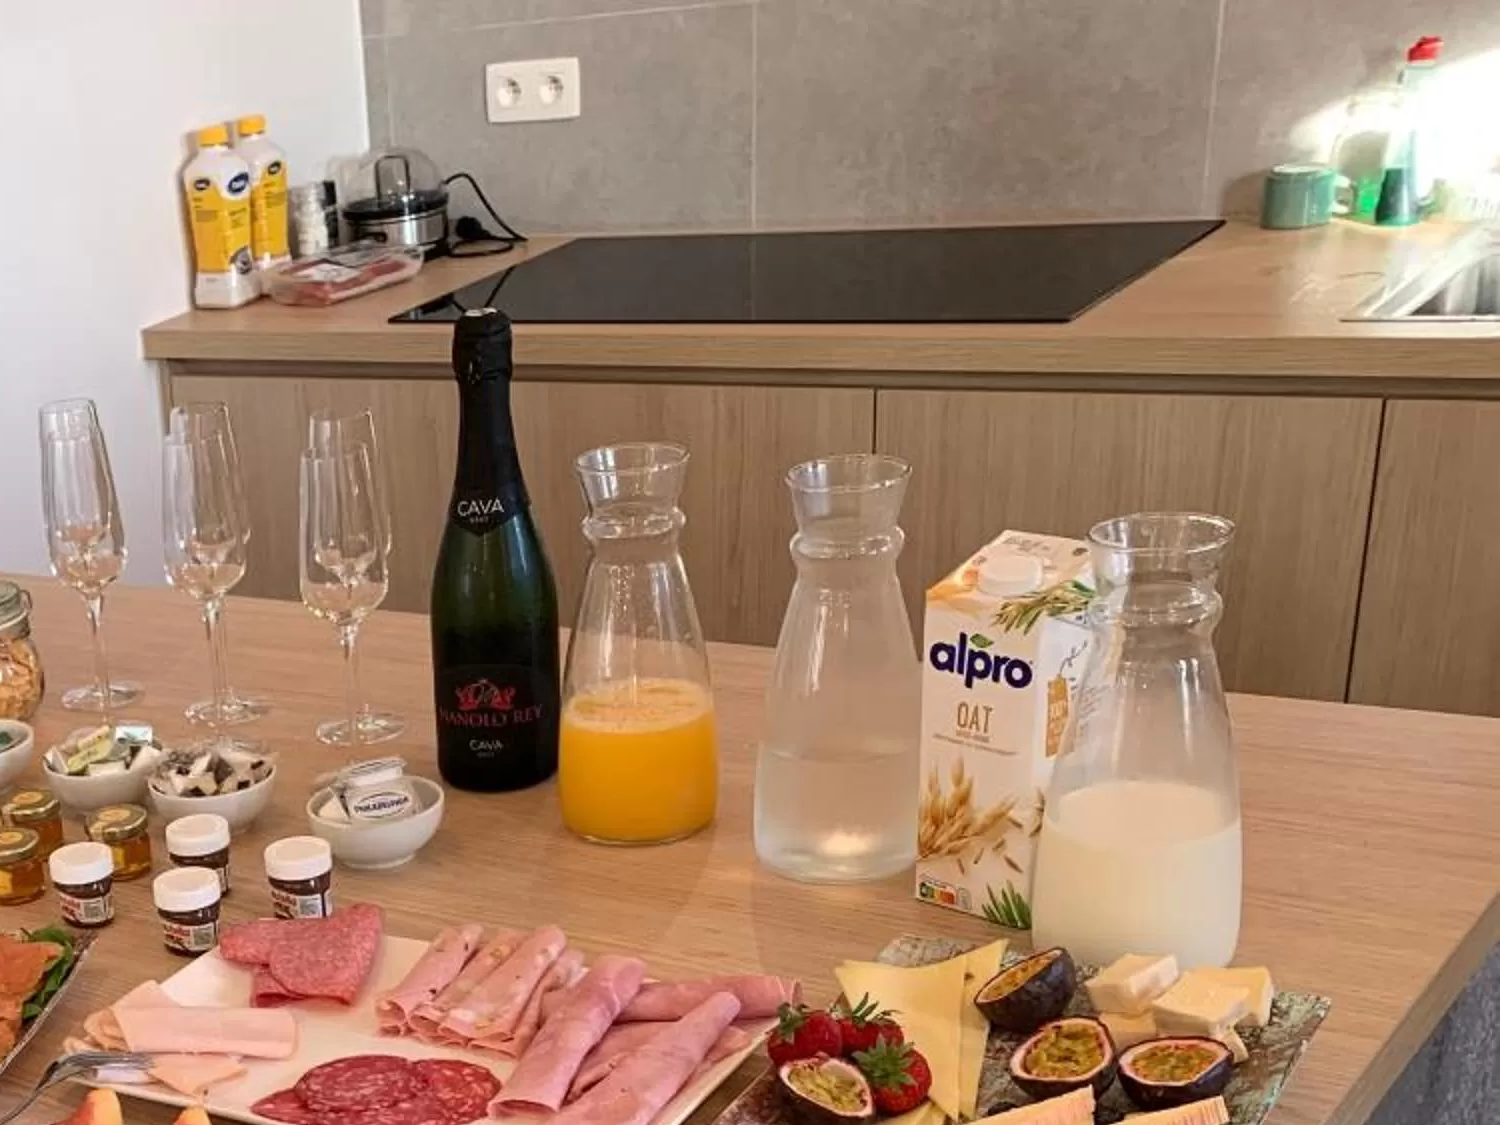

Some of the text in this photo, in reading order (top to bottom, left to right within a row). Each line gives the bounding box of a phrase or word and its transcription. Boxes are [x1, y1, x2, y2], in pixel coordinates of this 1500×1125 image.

[457, 497, 505, 517] CAVA
[929, 631, 1033, 689] alpro
[957, 701, 994, 734] OAT
[468, 738, 504, 752] CAVA
